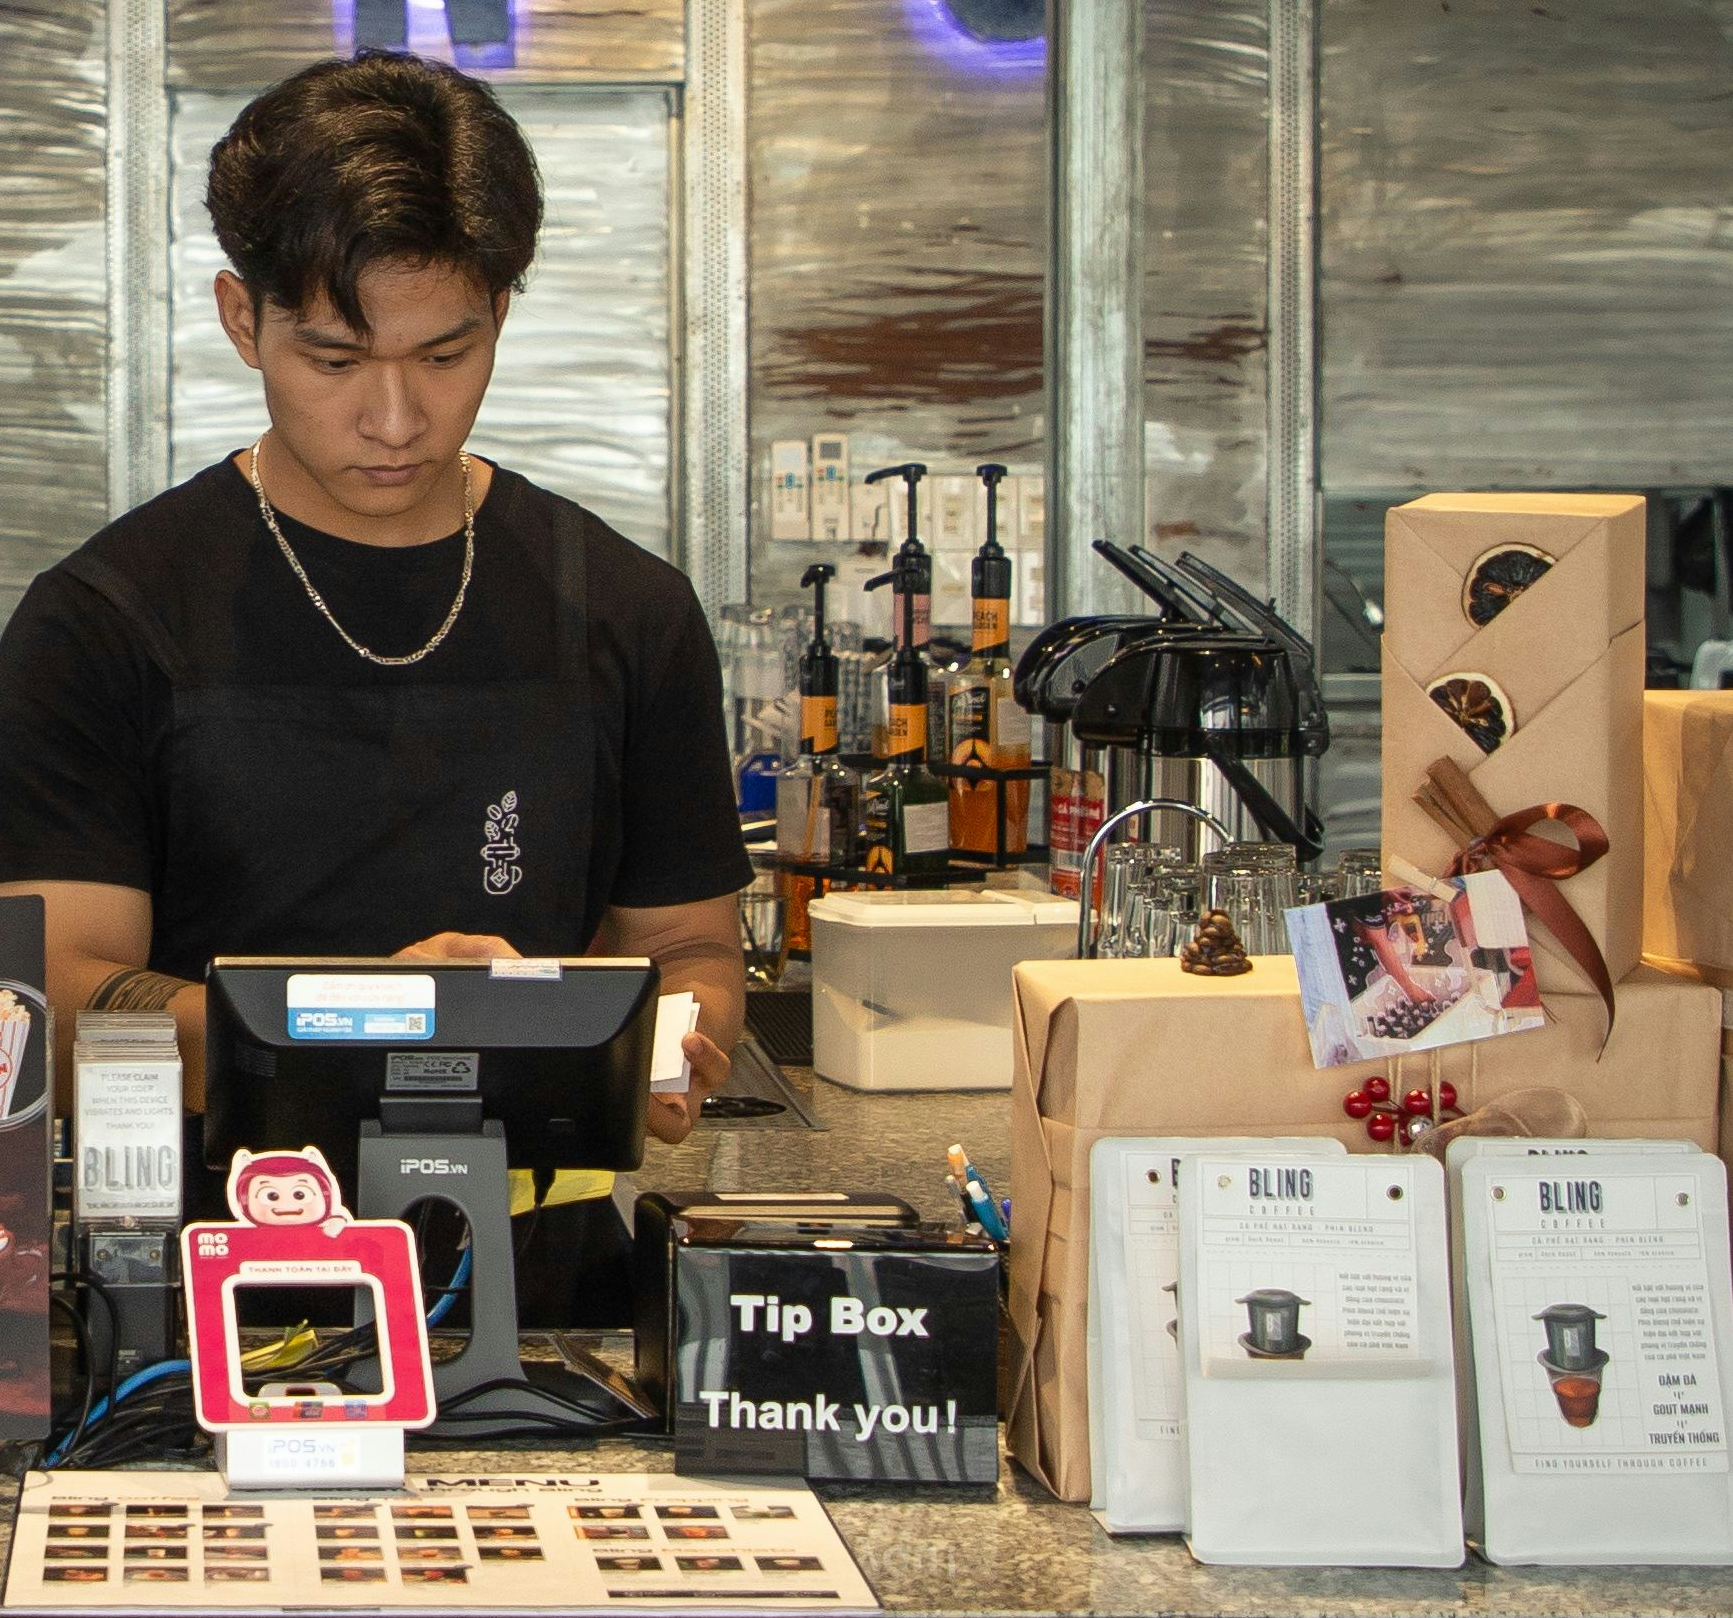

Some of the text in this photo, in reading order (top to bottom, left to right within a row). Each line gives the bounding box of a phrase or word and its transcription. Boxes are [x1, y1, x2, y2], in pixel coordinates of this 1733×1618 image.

[133, 1073, 159, 1081] CLAIM
[119, 1096, 138, 1104] THIS
[140, 1096, 168, 1104] DEVICE
[125, 1108, 143, 1116] AND
[106, 1122, 132, 1130] THANK
[84, 1145, 177, 1191] BLING
[400, 1158, 468, 1174] iPOS.VN
[1249, 1167, 1315, 1200] BLING
[1539, 1181, 1604, 1214] BLING
[1249, 1205, 1315, 1216] COFFEE
[1541, 1219, 1605, 1229] COFFEE
[730, 1294, 930, 1343] Tip Box
[1653, 1404, 1678, 1415] GOUT
[699, 1390, 957, 1441] Thank you!
[1535, 1457, 1707, 1468] FIND YOURSELF THROUGH COFFEE
[426, 1478, 600, 1487] MENU
